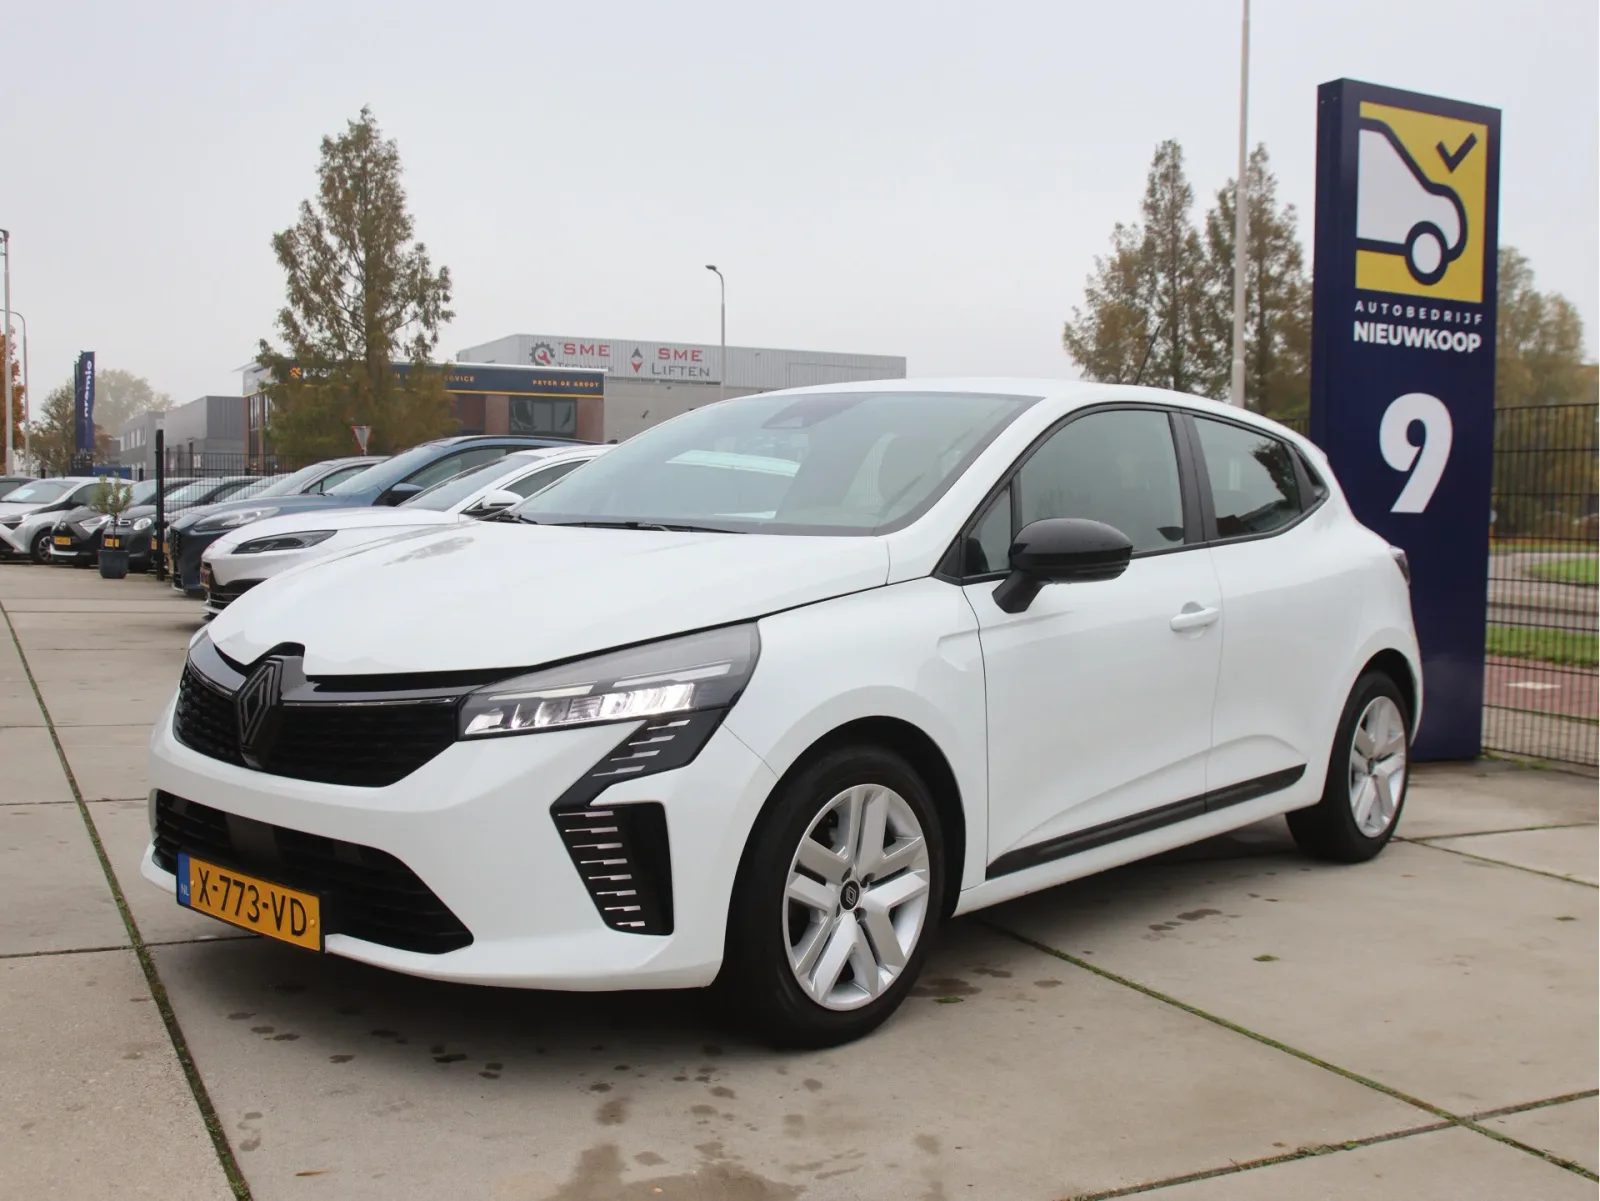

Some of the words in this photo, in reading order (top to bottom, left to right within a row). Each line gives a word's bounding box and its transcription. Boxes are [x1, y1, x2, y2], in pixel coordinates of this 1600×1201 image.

[1354, 300, 1483, 325] AUTOBEDRIJF
[1353, 321, 1482, 353] NIEUWKOOP
[563, 343, 610, 357] SME
[658, 347, 703, 362] SME
[651, 362, 710, 377] LIFTEN
[1379, 392, 1453, 514] 9
[180, 883, 190, 897] NL
[198, 867, 307, 937] X-773-VD
